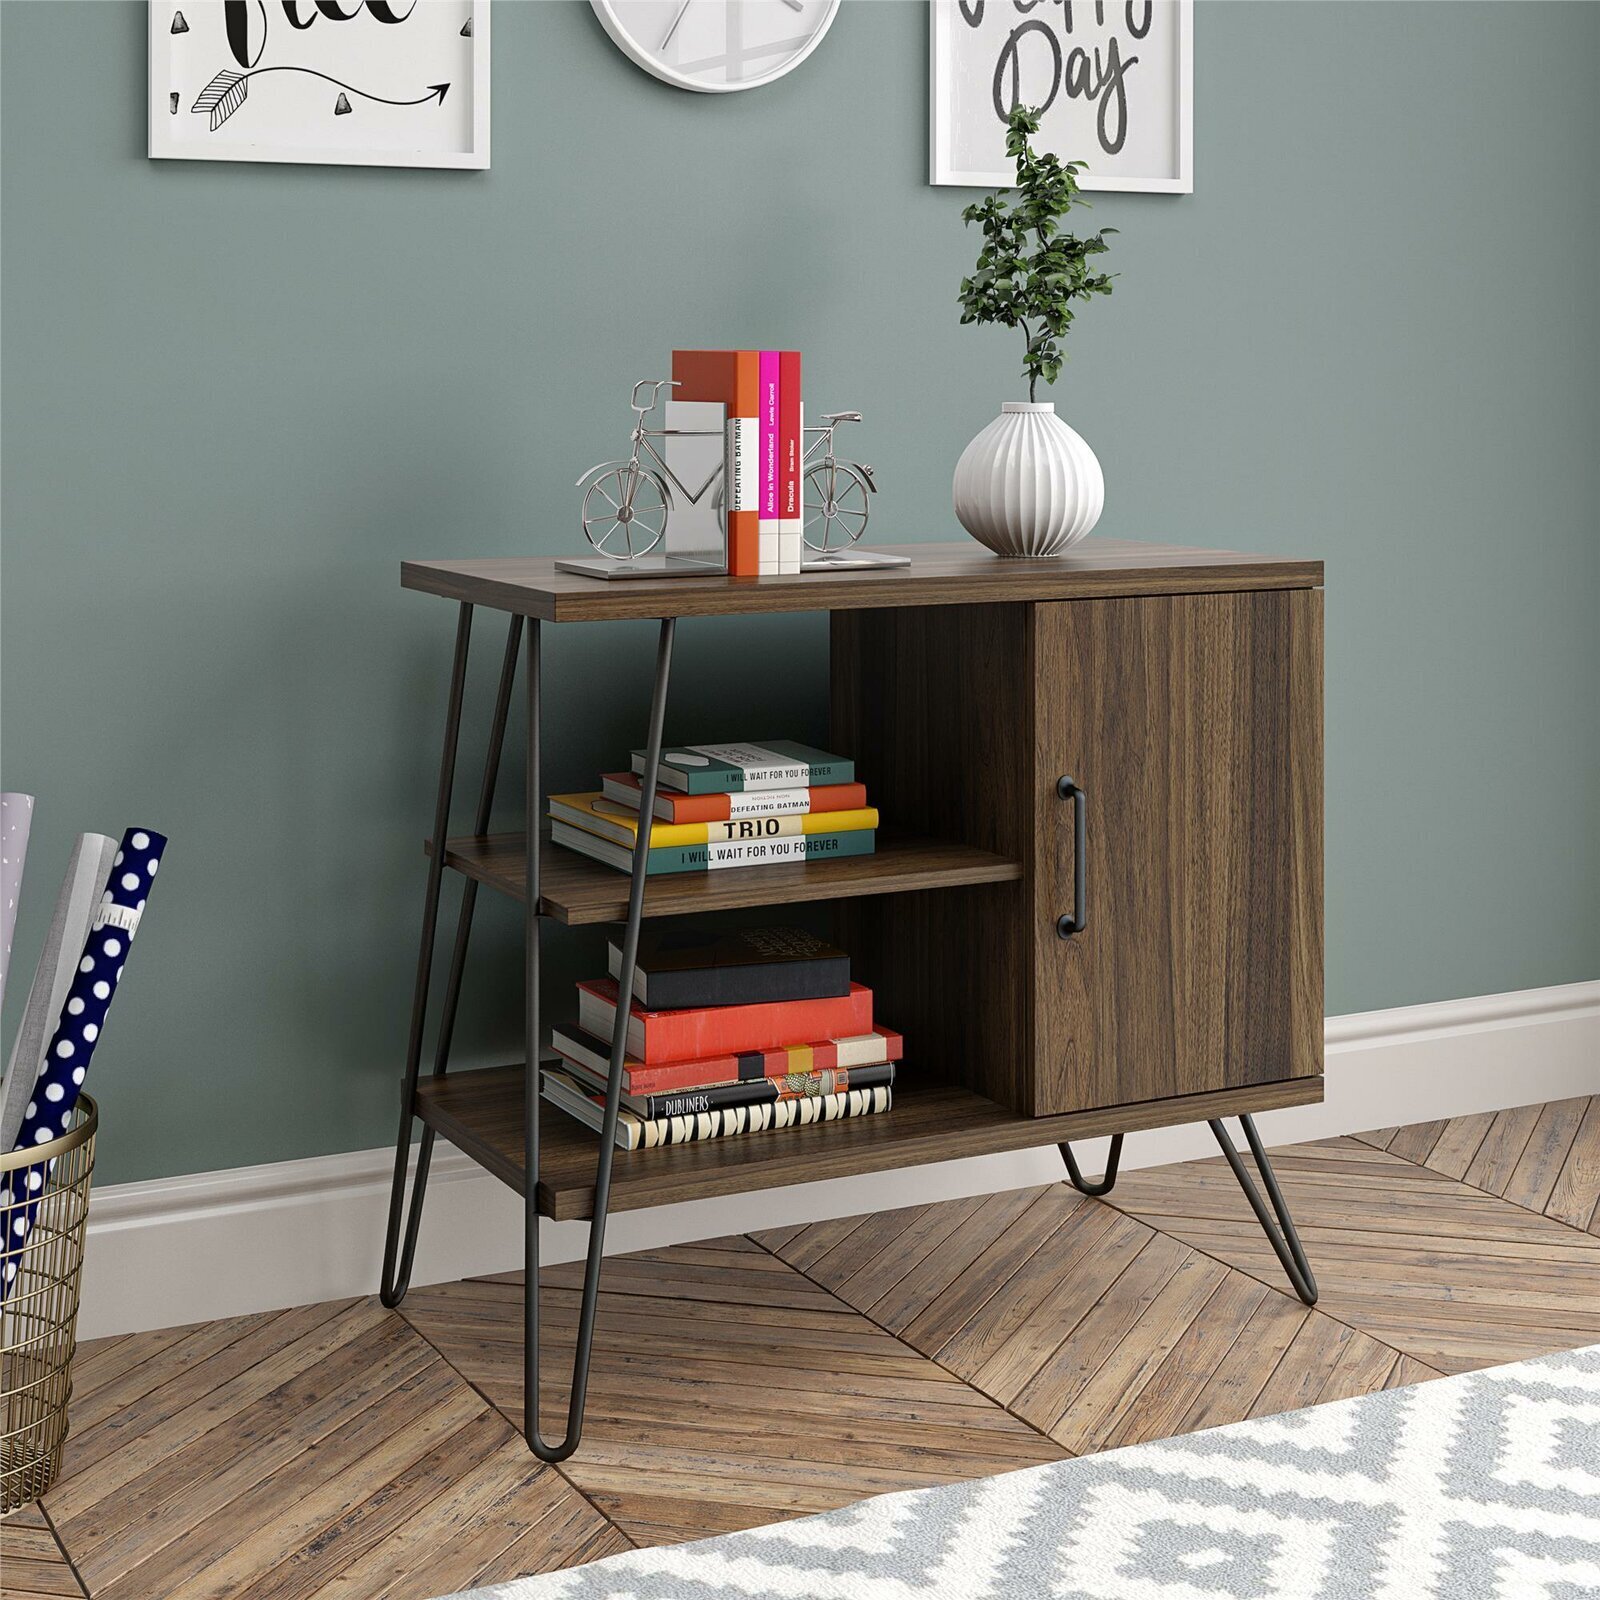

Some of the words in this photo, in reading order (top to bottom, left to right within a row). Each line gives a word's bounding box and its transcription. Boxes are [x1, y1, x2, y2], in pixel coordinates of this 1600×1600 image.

[992, 19, 1139, 155] Day
[734, 418, 742, 457] BATMAN
[734, 461, 742, 511] DEFEATING
[767, 483, 774, 491] in
[731, 773, 748, 782] WILL
[749, 771, 767, 780] WAIT
[769, 770, 783, 779] FOR
[784, 769, 799, 778] YOU
[800, 767, 832, 777] FOREVER
[731, 803, 774, 813] DEFEATING
[776, 800, 810, 810] BATMAN
[723, 818, 780, 839] TRIO
[681, 852, 685, 864] I
[688, 850, 714, 863] WILL
[717, 847, 743, 860] WAIT
[747, 845, 766, 858] FOR
[770, 843, 790, 856] YOU
[793, 839, 838, 853] FOREVER
[665, 1095, 709, 1116] DUBLINERS
